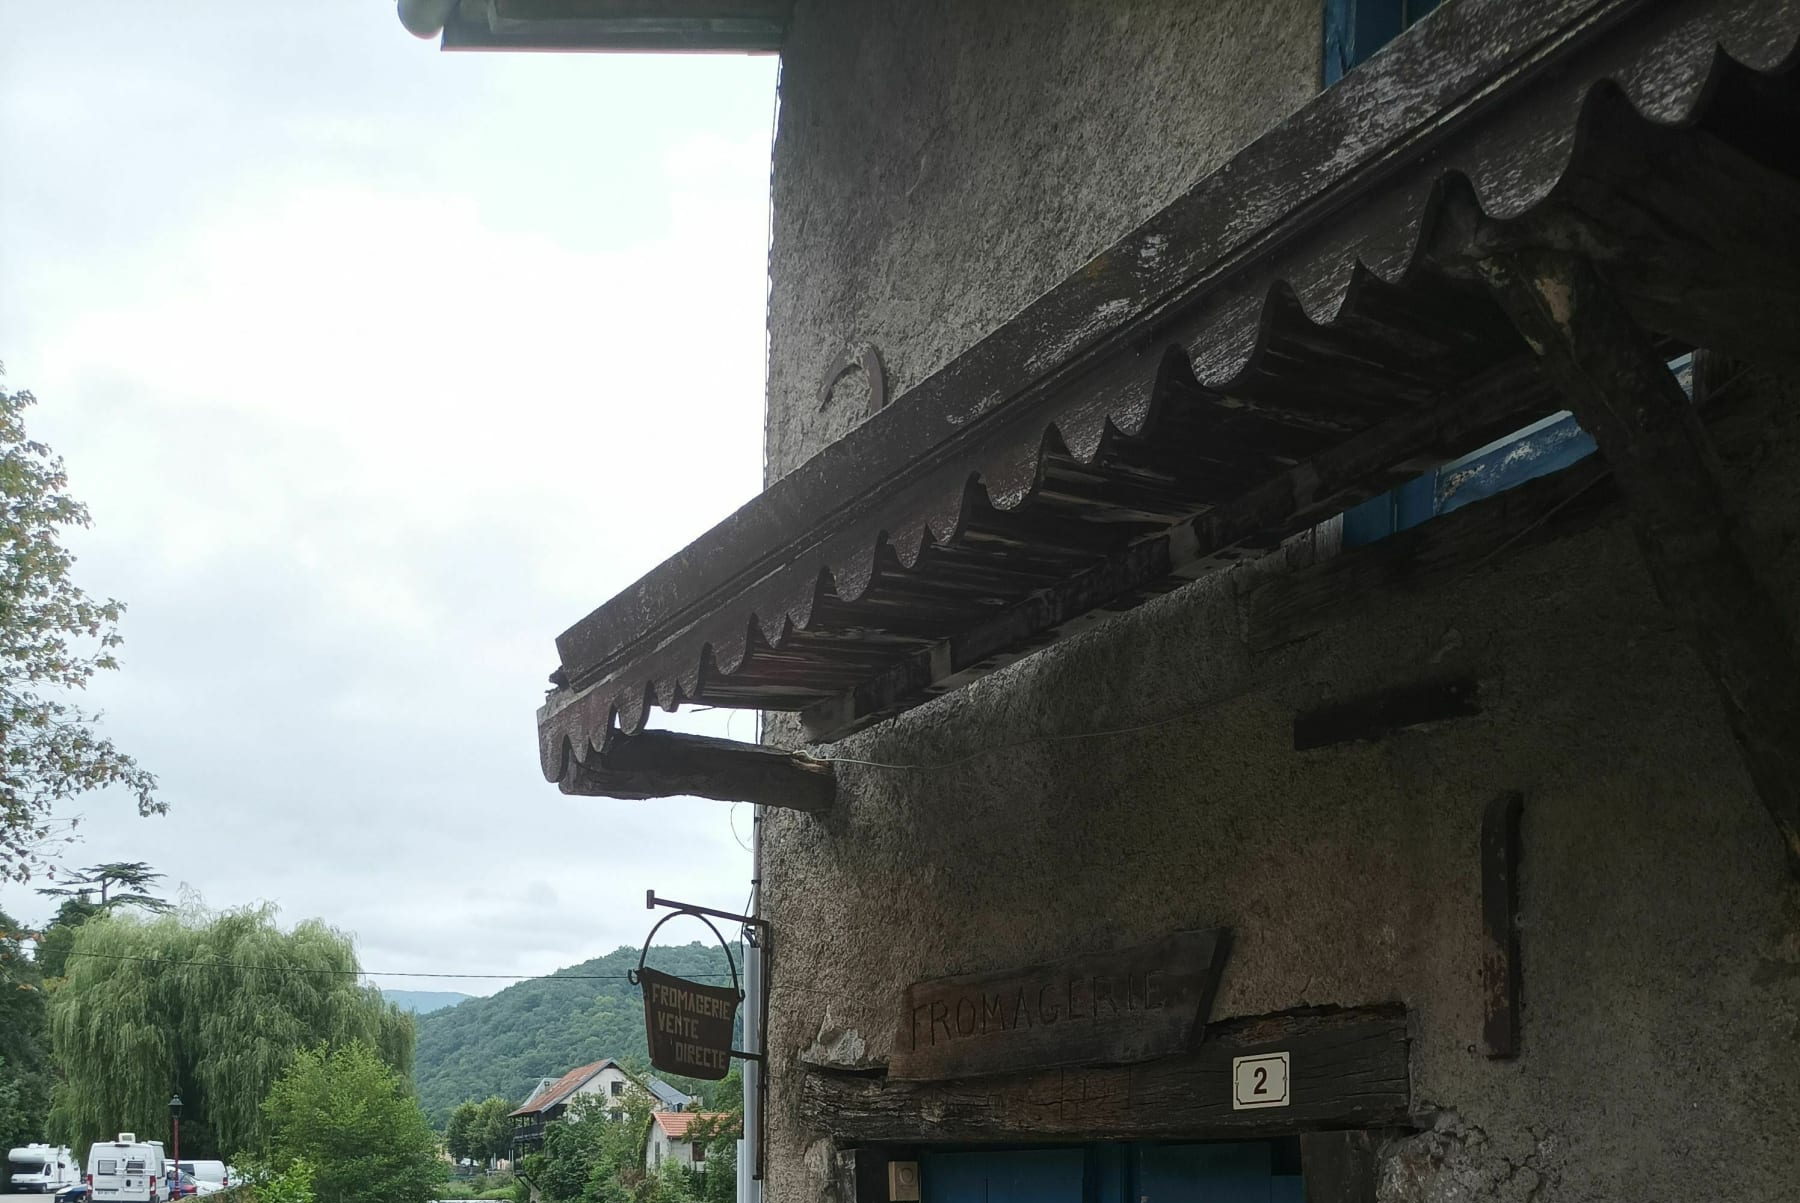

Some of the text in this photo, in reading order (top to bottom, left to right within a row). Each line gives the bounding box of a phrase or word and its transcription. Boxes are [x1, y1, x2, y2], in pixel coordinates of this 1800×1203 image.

[652, 982, 731, 1021] FROMAGERIE
[911, 968, 1167, 1050] FROMAGERIE
[657, 1010, 699, 1040] VENTE
[675, 1041, 728, 1070] DIRECTE
[1253, 1066, 1268, 1095] 2
